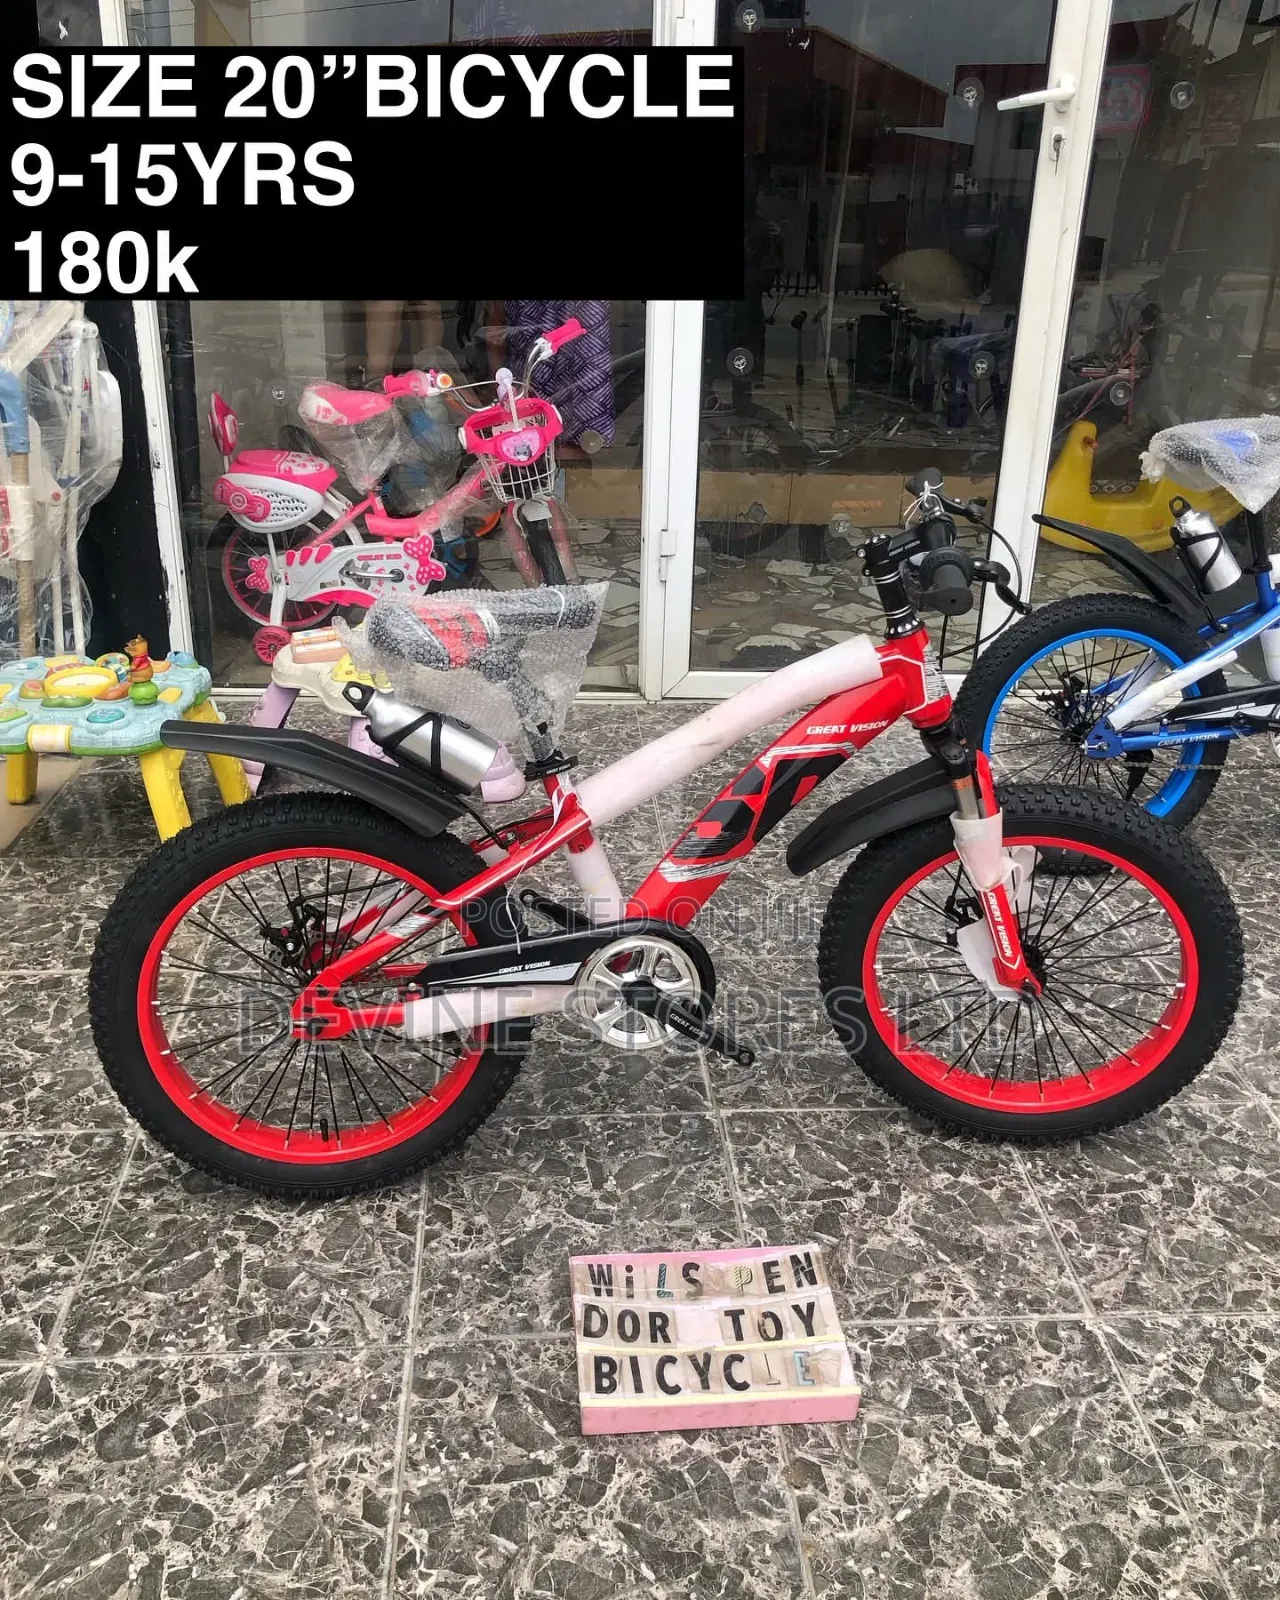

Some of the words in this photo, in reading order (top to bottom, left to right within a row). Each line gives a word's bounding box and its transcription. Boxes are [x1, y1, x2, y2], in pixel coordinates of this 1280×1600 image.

[806, 724, 848, 735] GREAT
[849, 719, 888, 733] VISION
[987, 891, 1004, 923] GREAT
[997, 925, 1014, 957] VISION
[498, 965, 524, 974] GREAT
[524, 960, 551, 970] VISION
[582, 1303, 672, 1344] DOR
[723, 1301, 816, 1342] TOY
